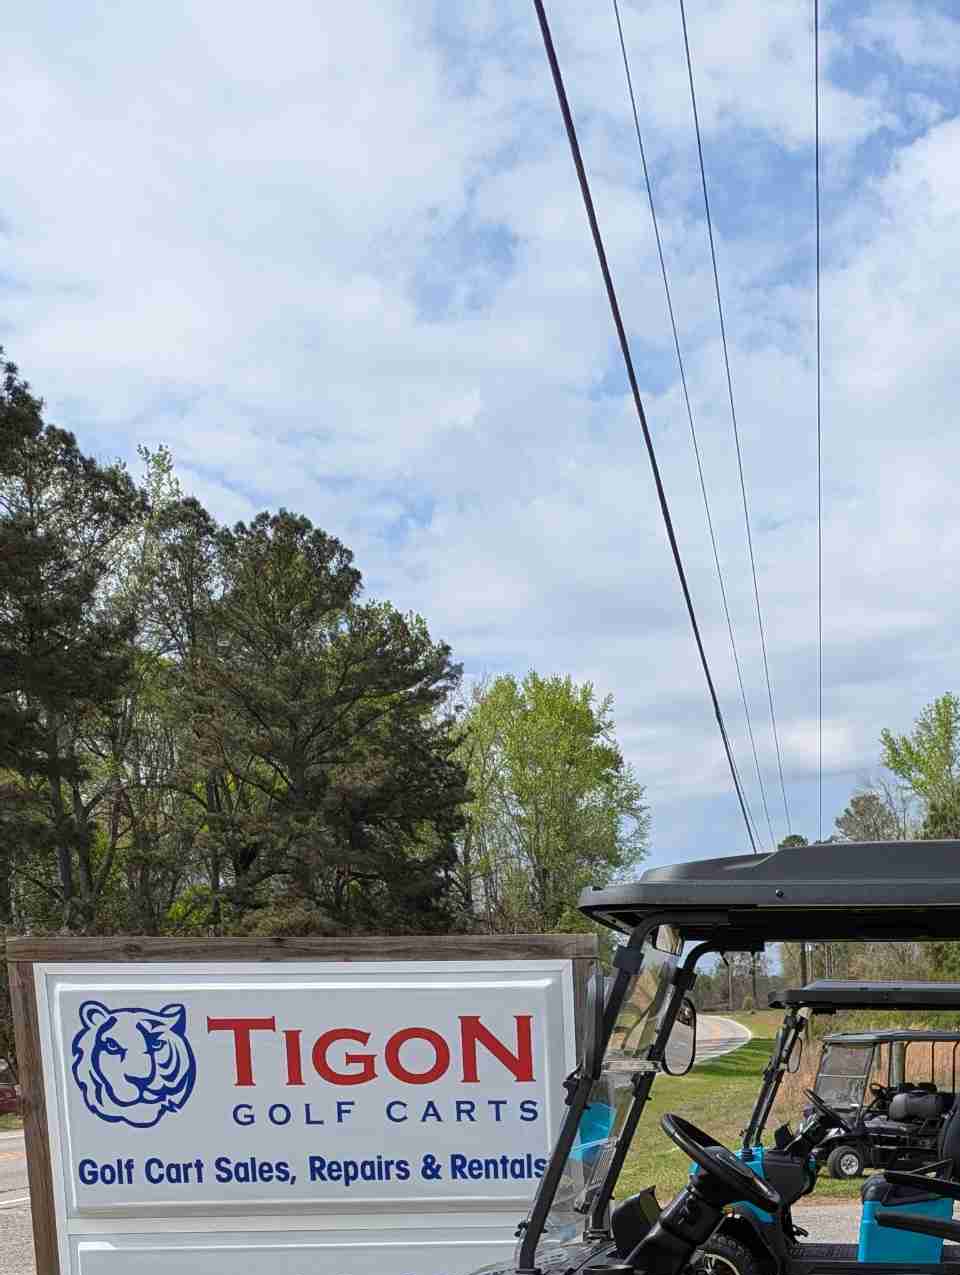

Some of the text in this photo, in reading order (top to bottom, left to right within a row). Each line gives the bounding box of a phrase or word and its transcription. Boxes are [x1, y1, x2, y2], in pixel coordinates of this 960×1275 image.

[206, 1014, 537, 1088] TIGON
[231, 1099, 540, 1126] GOLF CARTS
[78, 1153, 547, 1187] Golf Cart Sales, Repairs & Rentals
